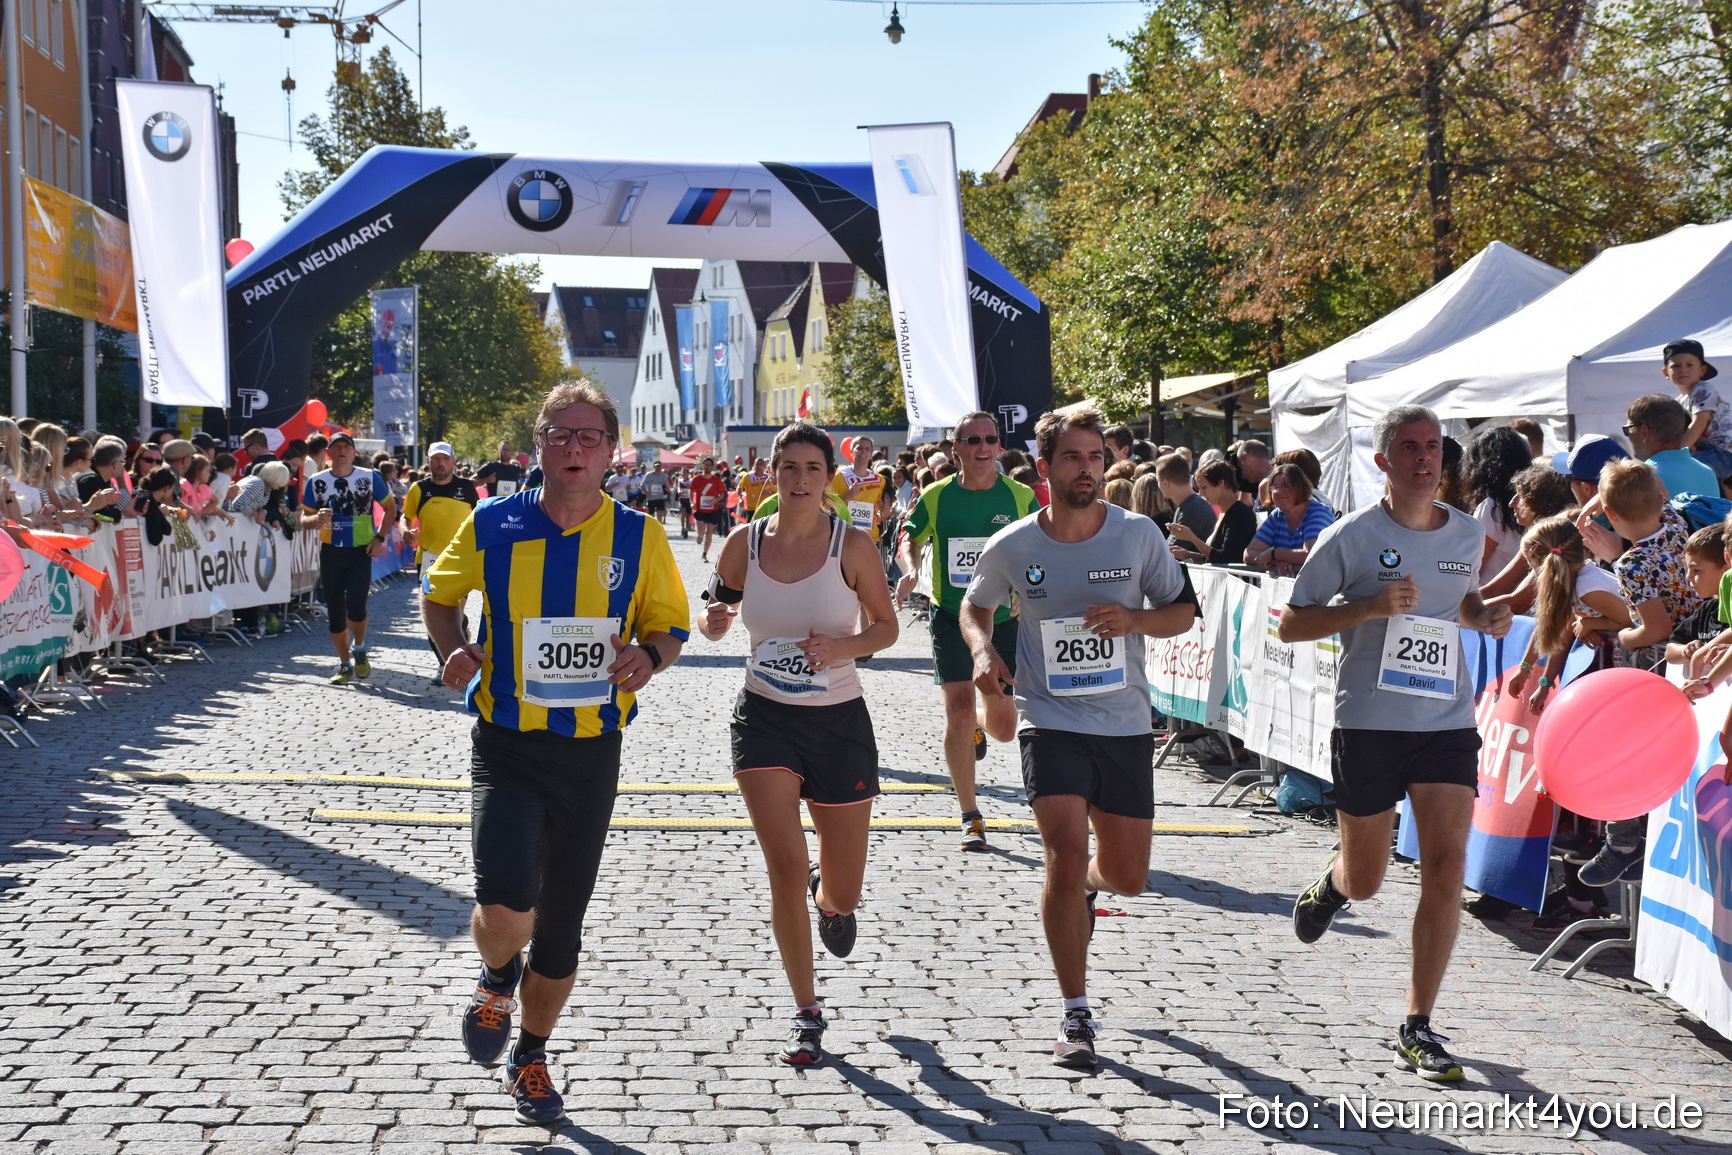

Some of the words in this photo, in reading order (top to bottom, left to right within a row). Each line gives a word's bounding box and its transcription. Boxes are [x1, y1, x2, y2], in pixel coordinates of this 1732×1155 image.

[513, 170, 568, 190] BMW
[241, 268, 302, 306] PARTL
[298, 212, 395, 275] NEUMARKT
[968, 281, 1023, 322] MARKT
[851, 508, 872, 519] 2398
[500, 522, 525, 530] erima
[1087, 567, 1132, 581] BOCK
[1437, 560, 1472, 575] BOCK
[1026, 588, 1048, 596] PARTL
[552, 625, 595, 636] BOCK
[1412, 622, 1444, 637] BOCK
[777, 641, 803, 653] BOC
[1055, 637, 1115, 663] 2630
[1396, 636, 1448, 667] 2381
[538, 642, 605, 670] 3059
[1062, 665, 1079, 674] PARTL
[1079, 663, 1104, 672] Neumarkt
[1400, 663, 1418, 672] PARTL
[1418, 667, 1442, 676] Neumarkt
[564, 672, 591, 681] Neumarkt
[1071, 675, 1104, 688] Stefan
[1408, 675, 1437, 690] David
